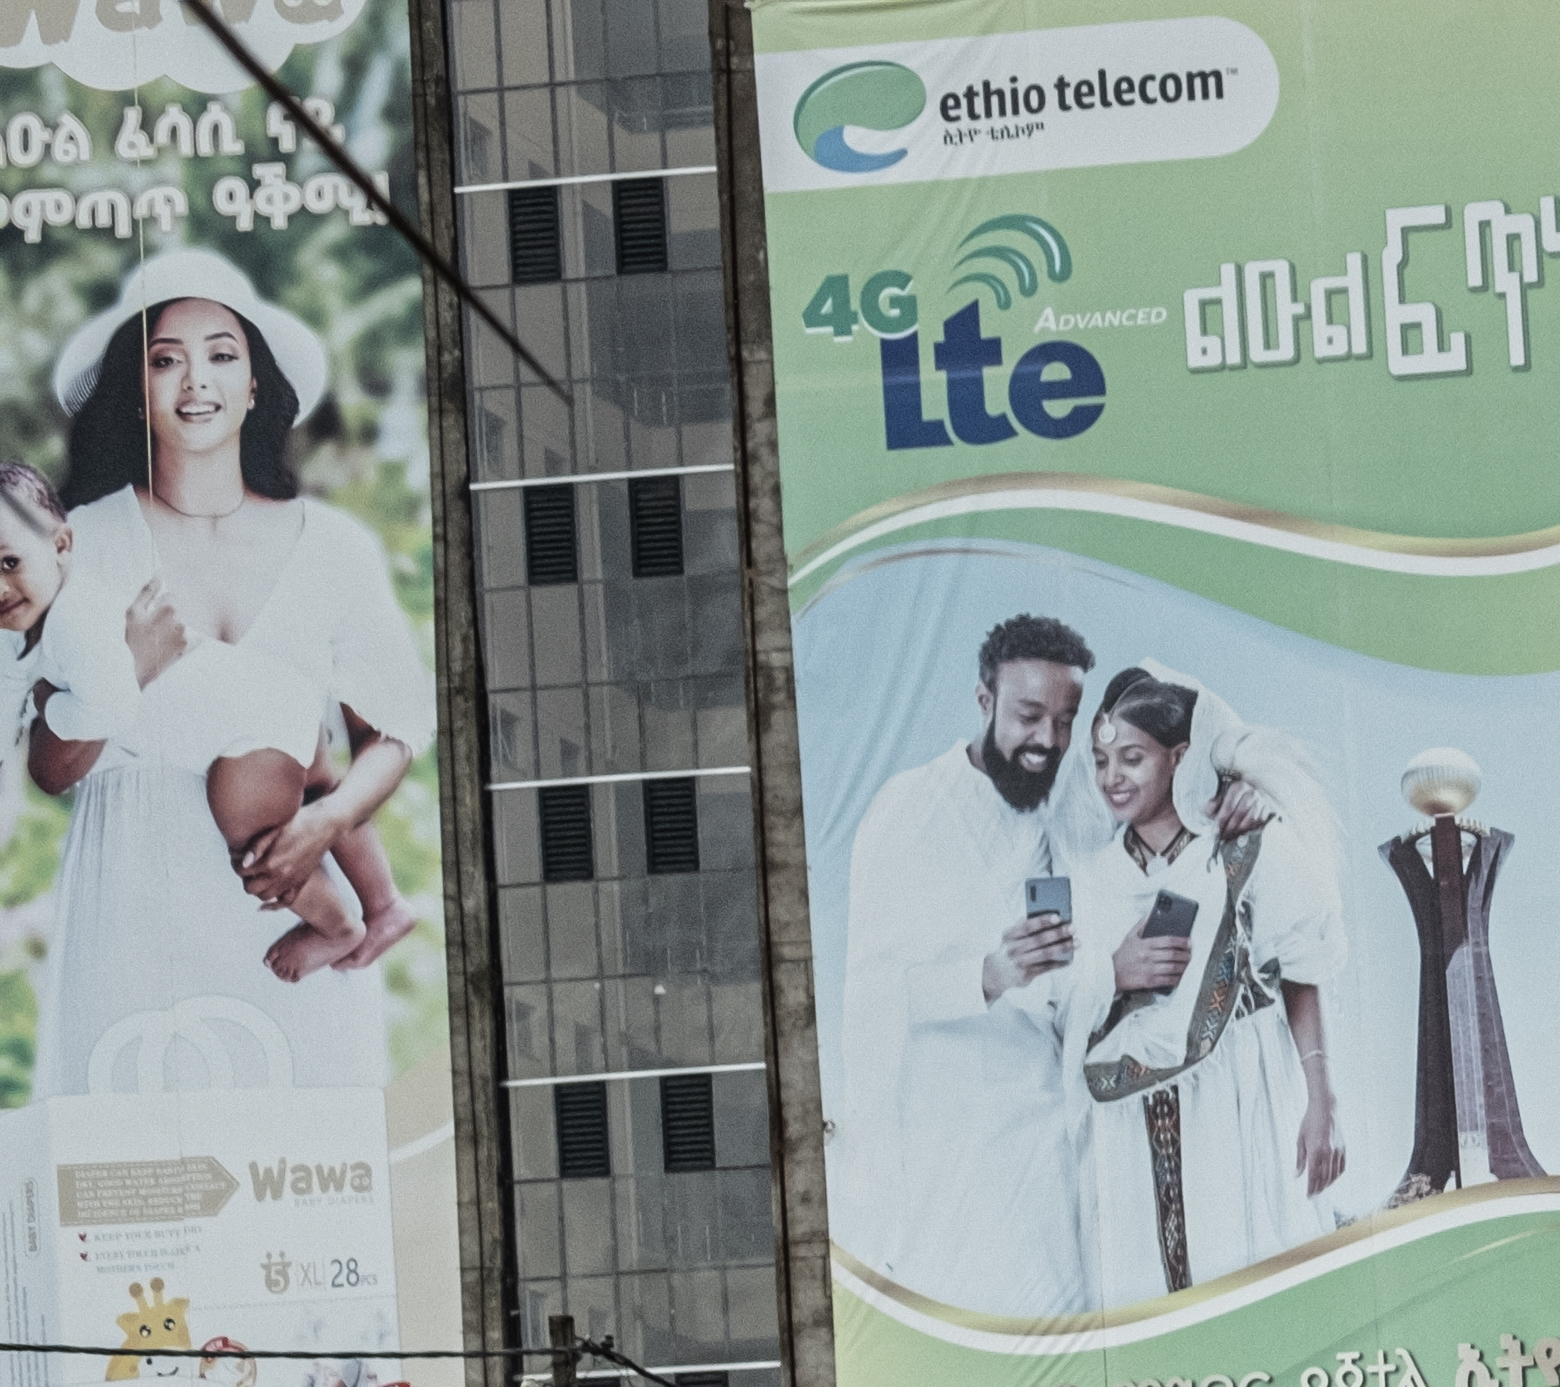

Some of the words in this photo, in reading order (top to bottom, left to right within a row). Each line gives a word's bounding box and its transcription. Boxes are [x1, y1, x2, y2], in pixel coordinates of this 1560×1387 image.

[940, 76, 1046, 122] ethio
[1054, 68, 1225, 112] telecom
[0, 108, 92, 168] ዑል
[801, 268, 919, 342] 4G
[1033, 304, 1168, 335] ADVANCED
[248, 1156, 374, 1202] Wawa
[330, 1257, 360, 1289] 28
